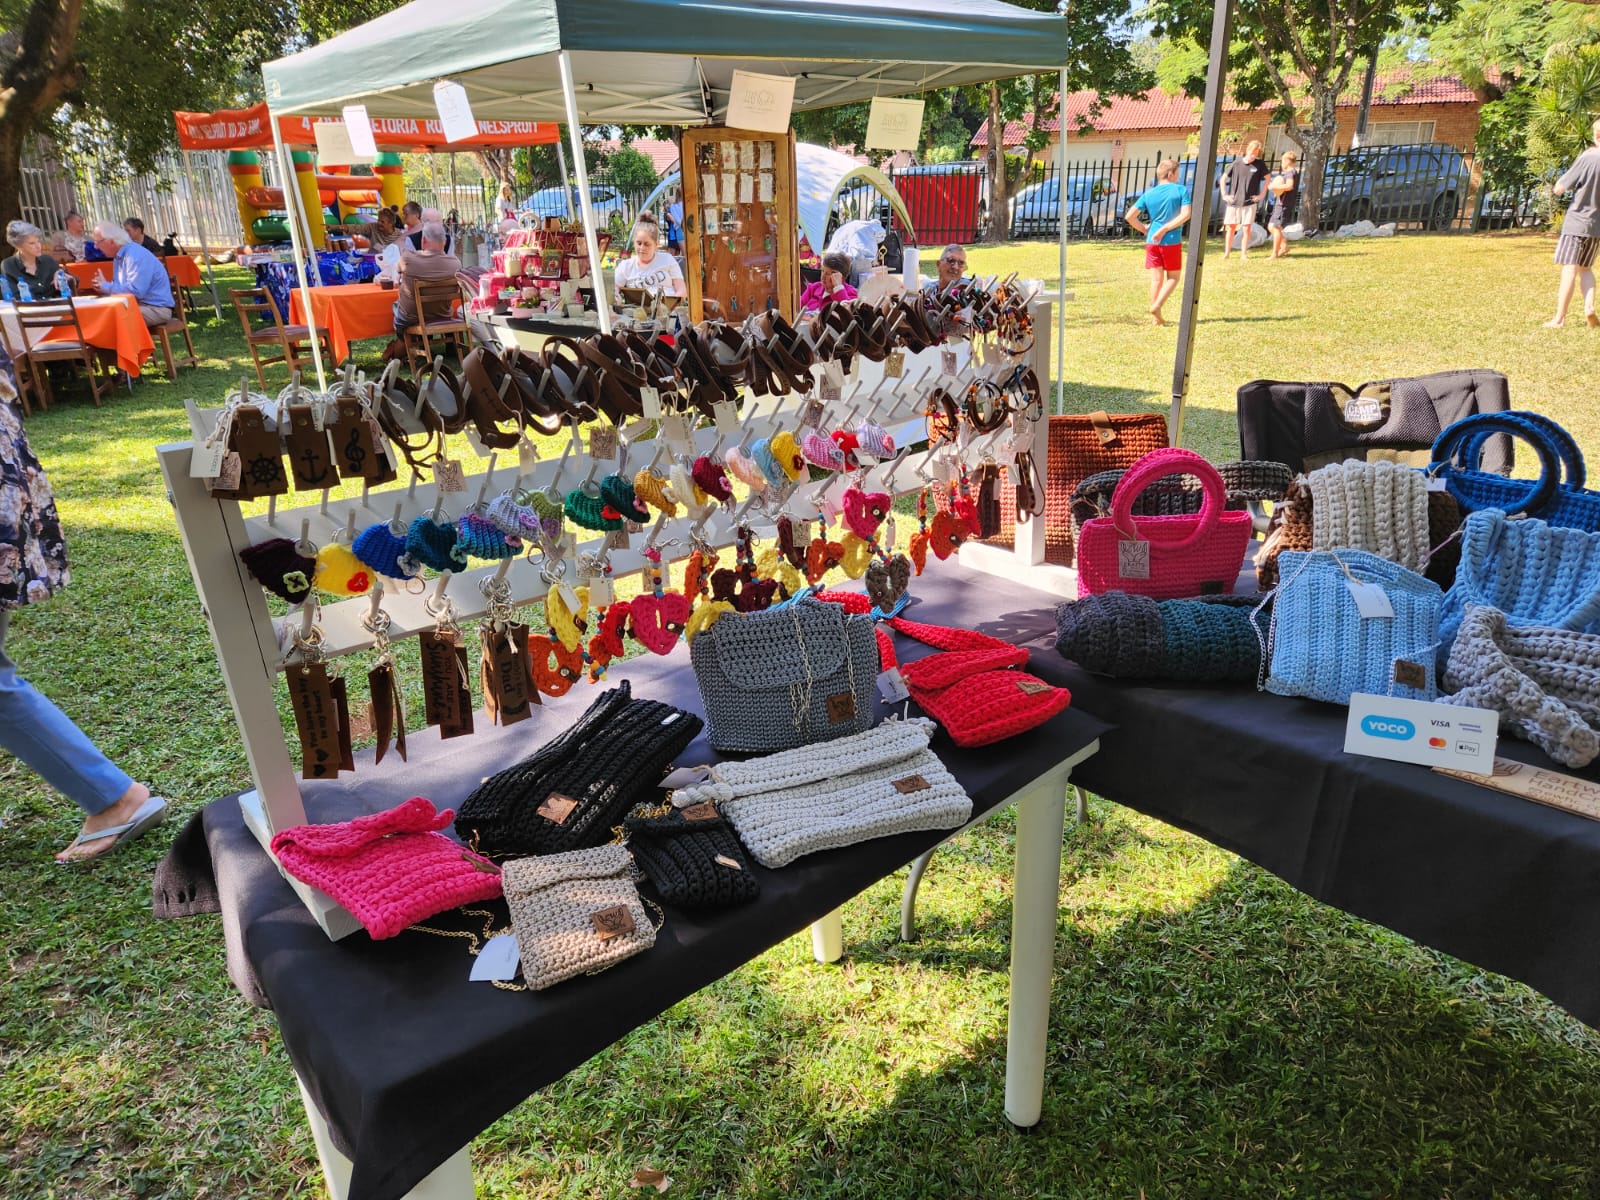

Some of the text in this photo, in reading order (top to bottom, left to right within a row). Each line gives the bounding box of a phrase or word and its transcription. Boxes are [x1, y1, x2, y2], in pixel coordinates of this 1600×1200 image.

[477, 119, 539, 134] NELSPRUIT
[501, 661, 516, 693] Dad
[1431, 719, 1451, 728] VISA
